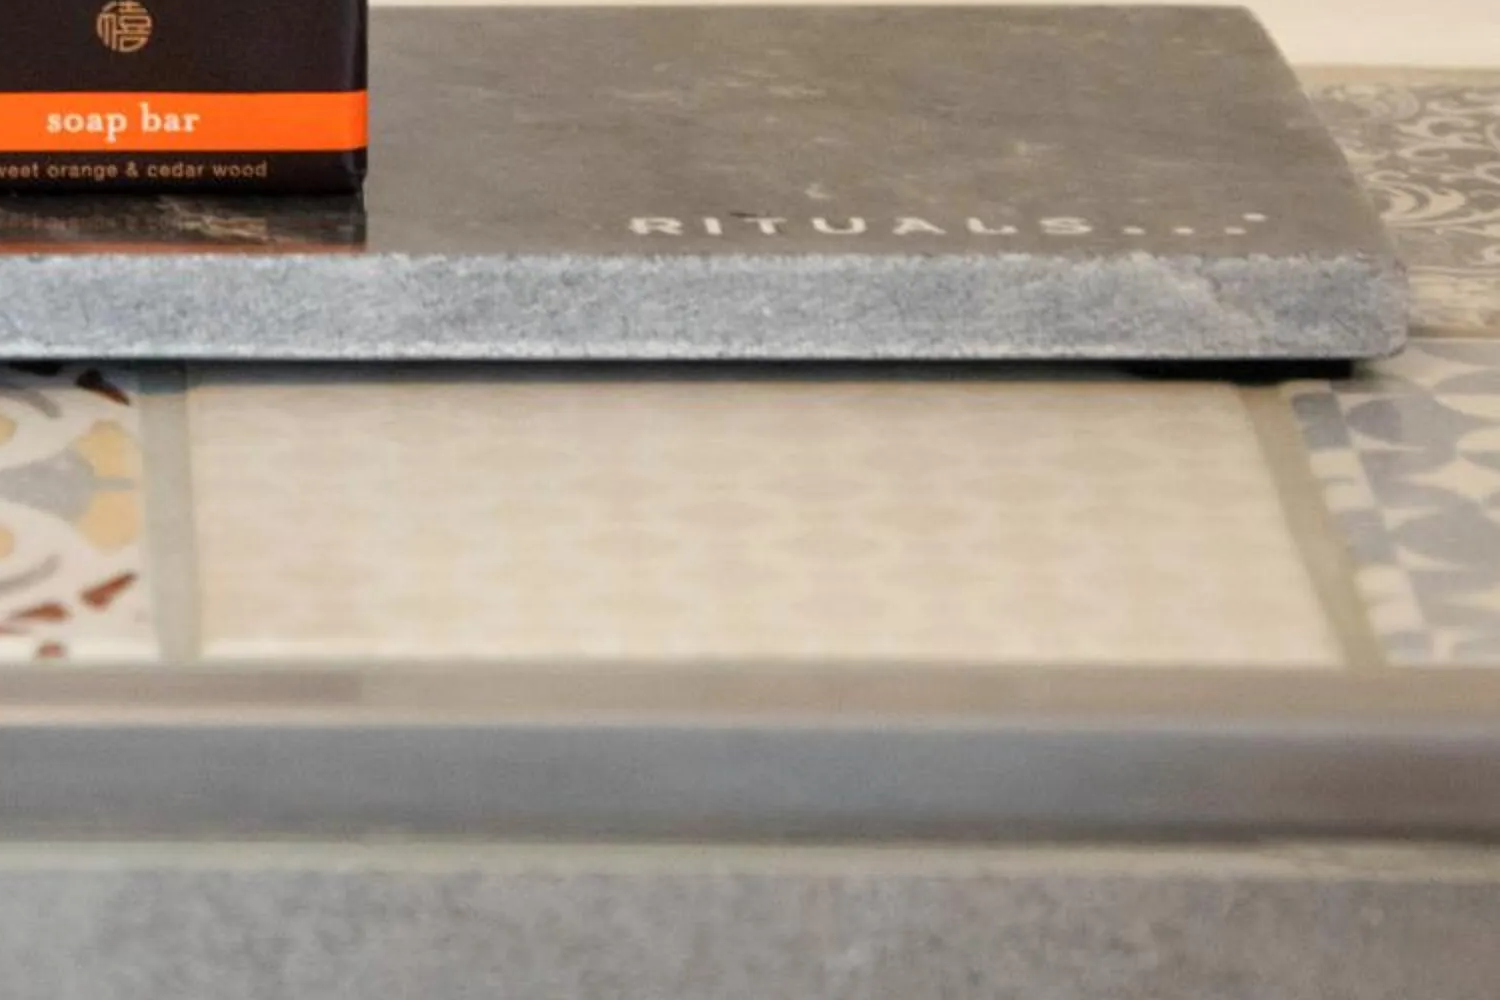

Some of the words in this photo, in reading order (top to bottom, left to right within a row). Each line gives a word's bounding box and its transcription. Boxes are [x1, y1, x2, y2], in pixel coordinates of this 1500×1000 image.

[46, 111, 128, 143] soap
[140, 102, 201, 133] bar
[46, 163, 118, 183] orange
[124, 160, 140, 178] &
[147, 159, 205, 179] cedar
[212, 159, 269, 178] wood
